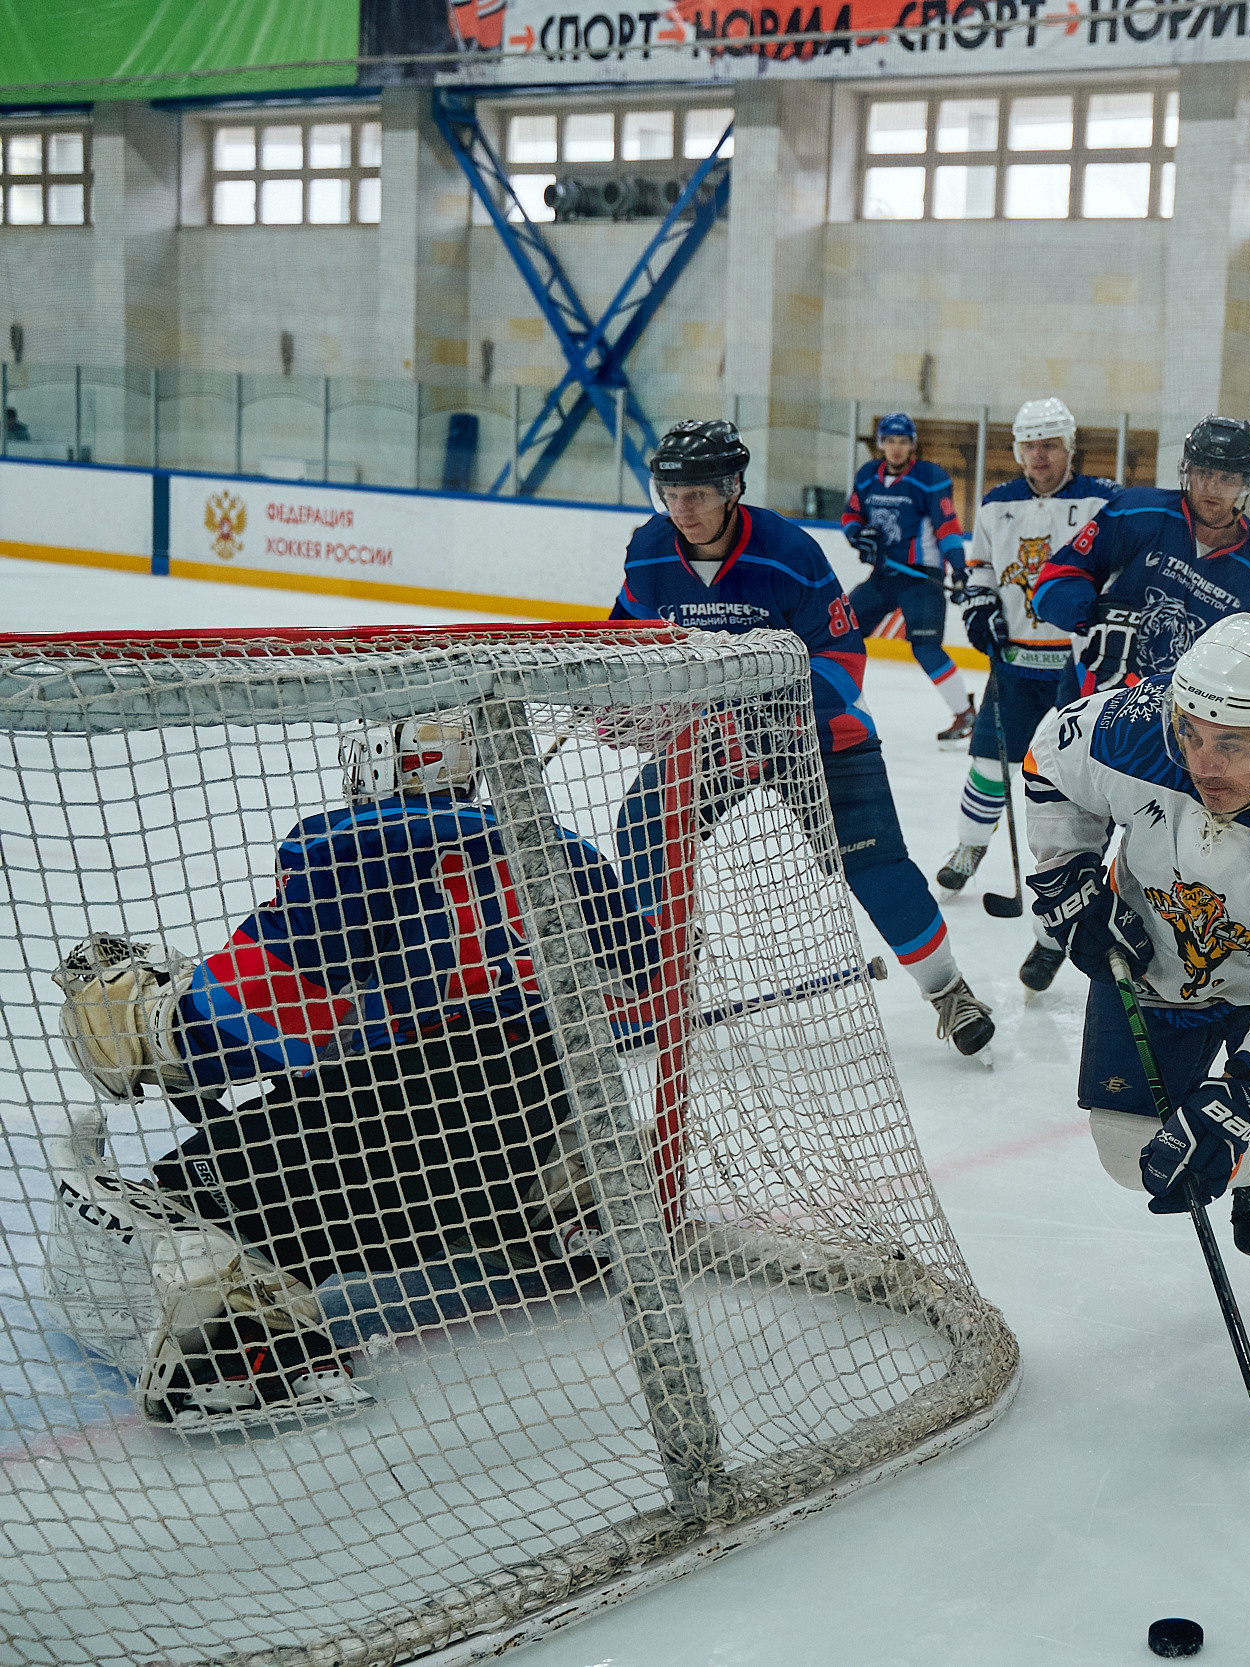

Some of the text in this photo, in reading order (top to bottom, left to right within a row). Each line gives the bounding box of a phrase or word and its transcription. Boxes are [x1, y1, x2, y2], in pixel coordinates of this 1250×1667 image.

[540, 12, 660, 61] СПОРТ
[694, 5, 851, 60] НОРМА
[897, 0, 1046, 51] СПОРТ
[266, 502, 354, 528] ФЕДЕРАЦИЯ
[266, 536, 393, 567] ХОККЕЯ РОССИИ
[1105, 608, 1142, 625] CC
[1038, 879, 1101, 928] AUER
